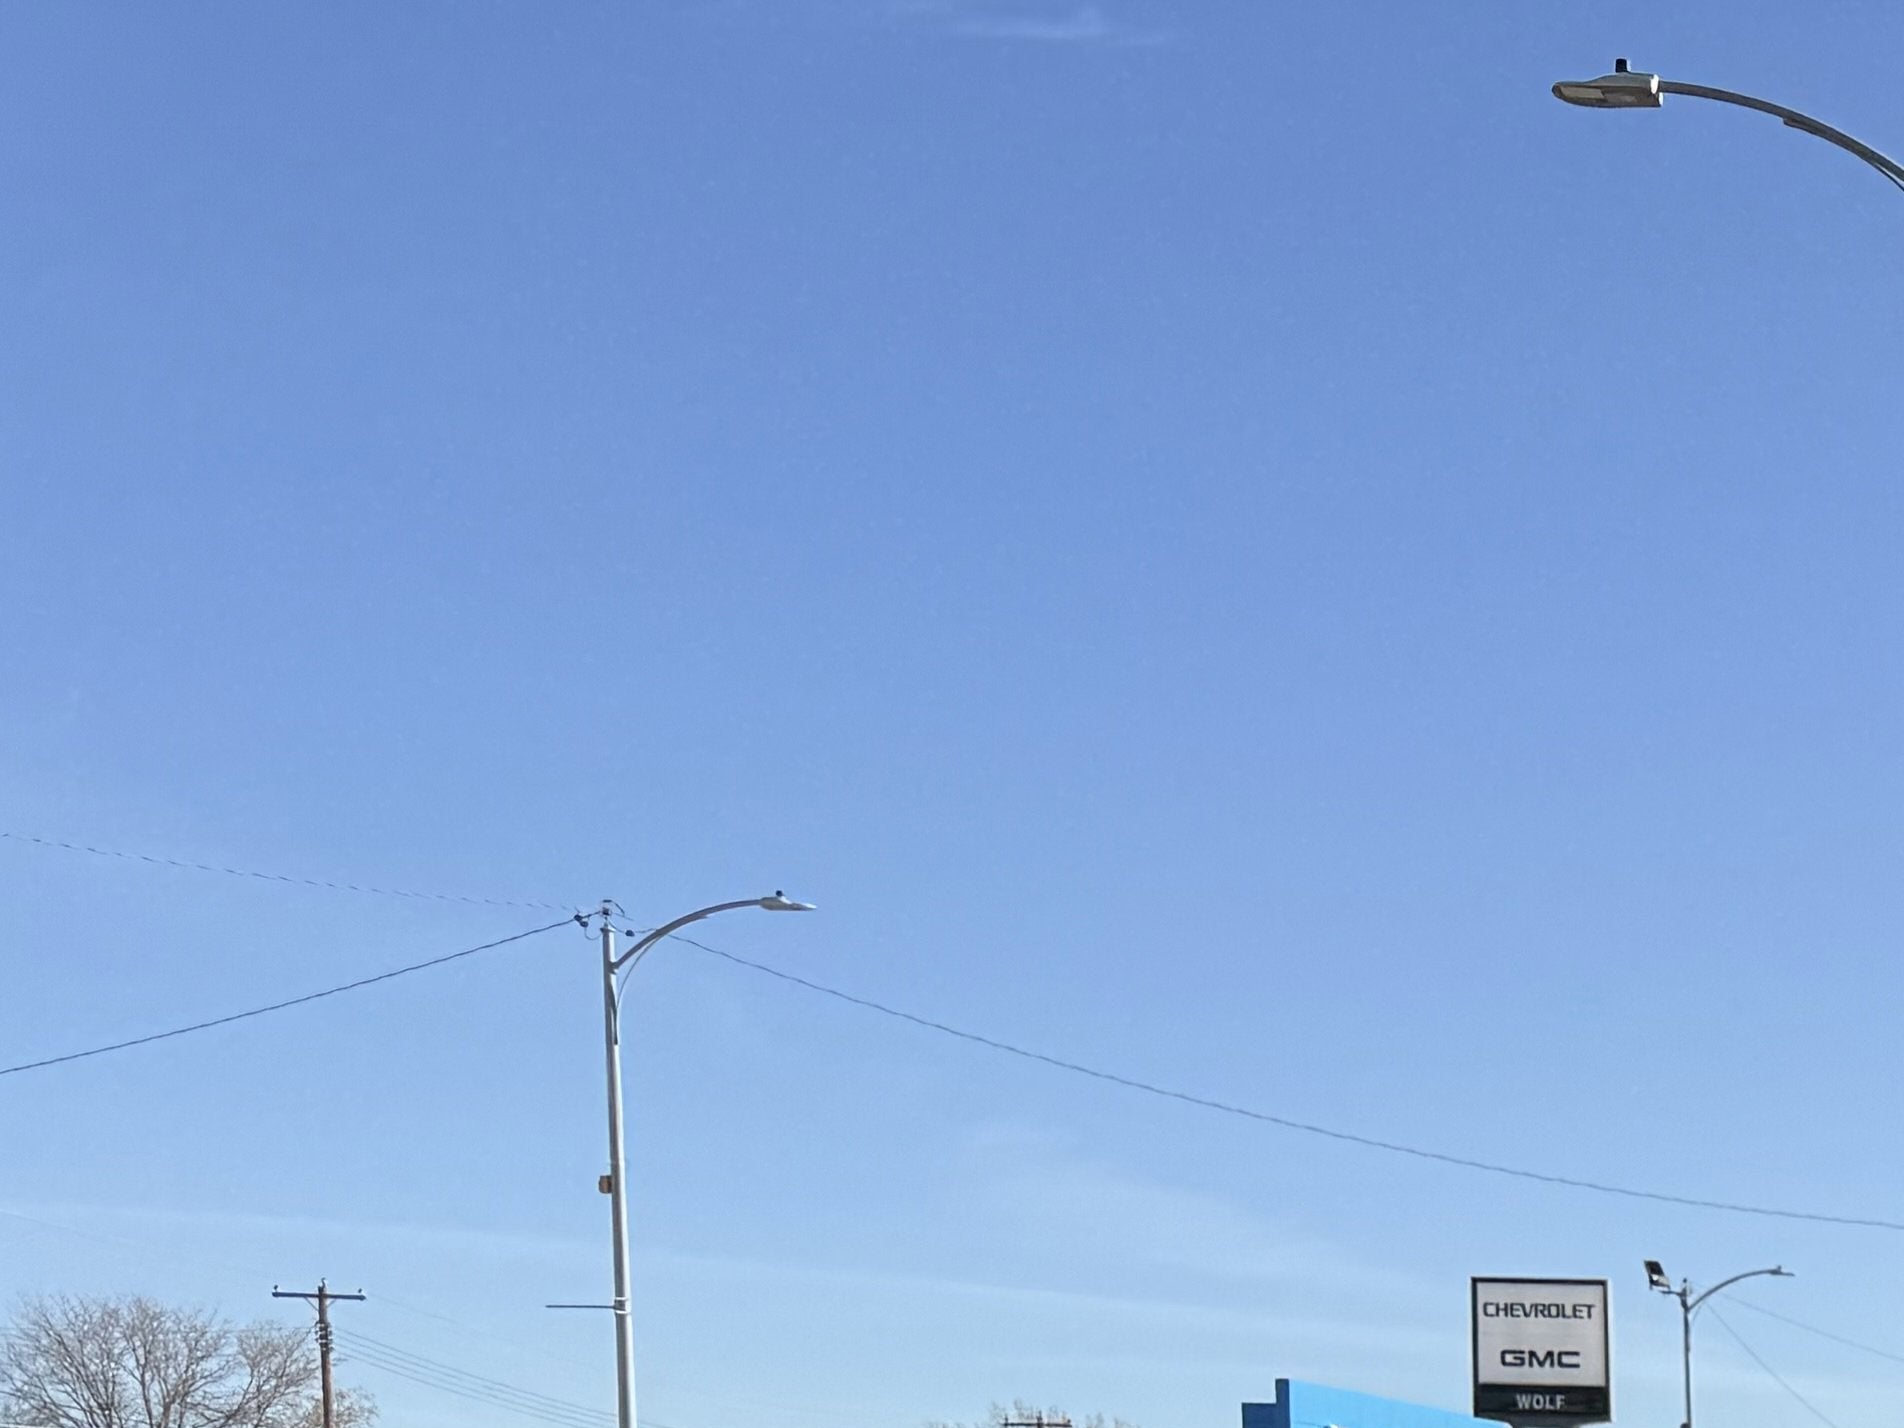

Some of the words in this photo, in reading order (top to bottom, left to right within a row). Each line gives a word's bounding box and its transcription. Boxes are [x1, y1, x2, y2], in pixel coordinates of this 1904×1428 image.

[1483, 1302, 1596, 1320] CHEVROLET
[1501, 1349, 1581, 1369] GMC
[1516, 1394, 1565, 1411] WOLF
